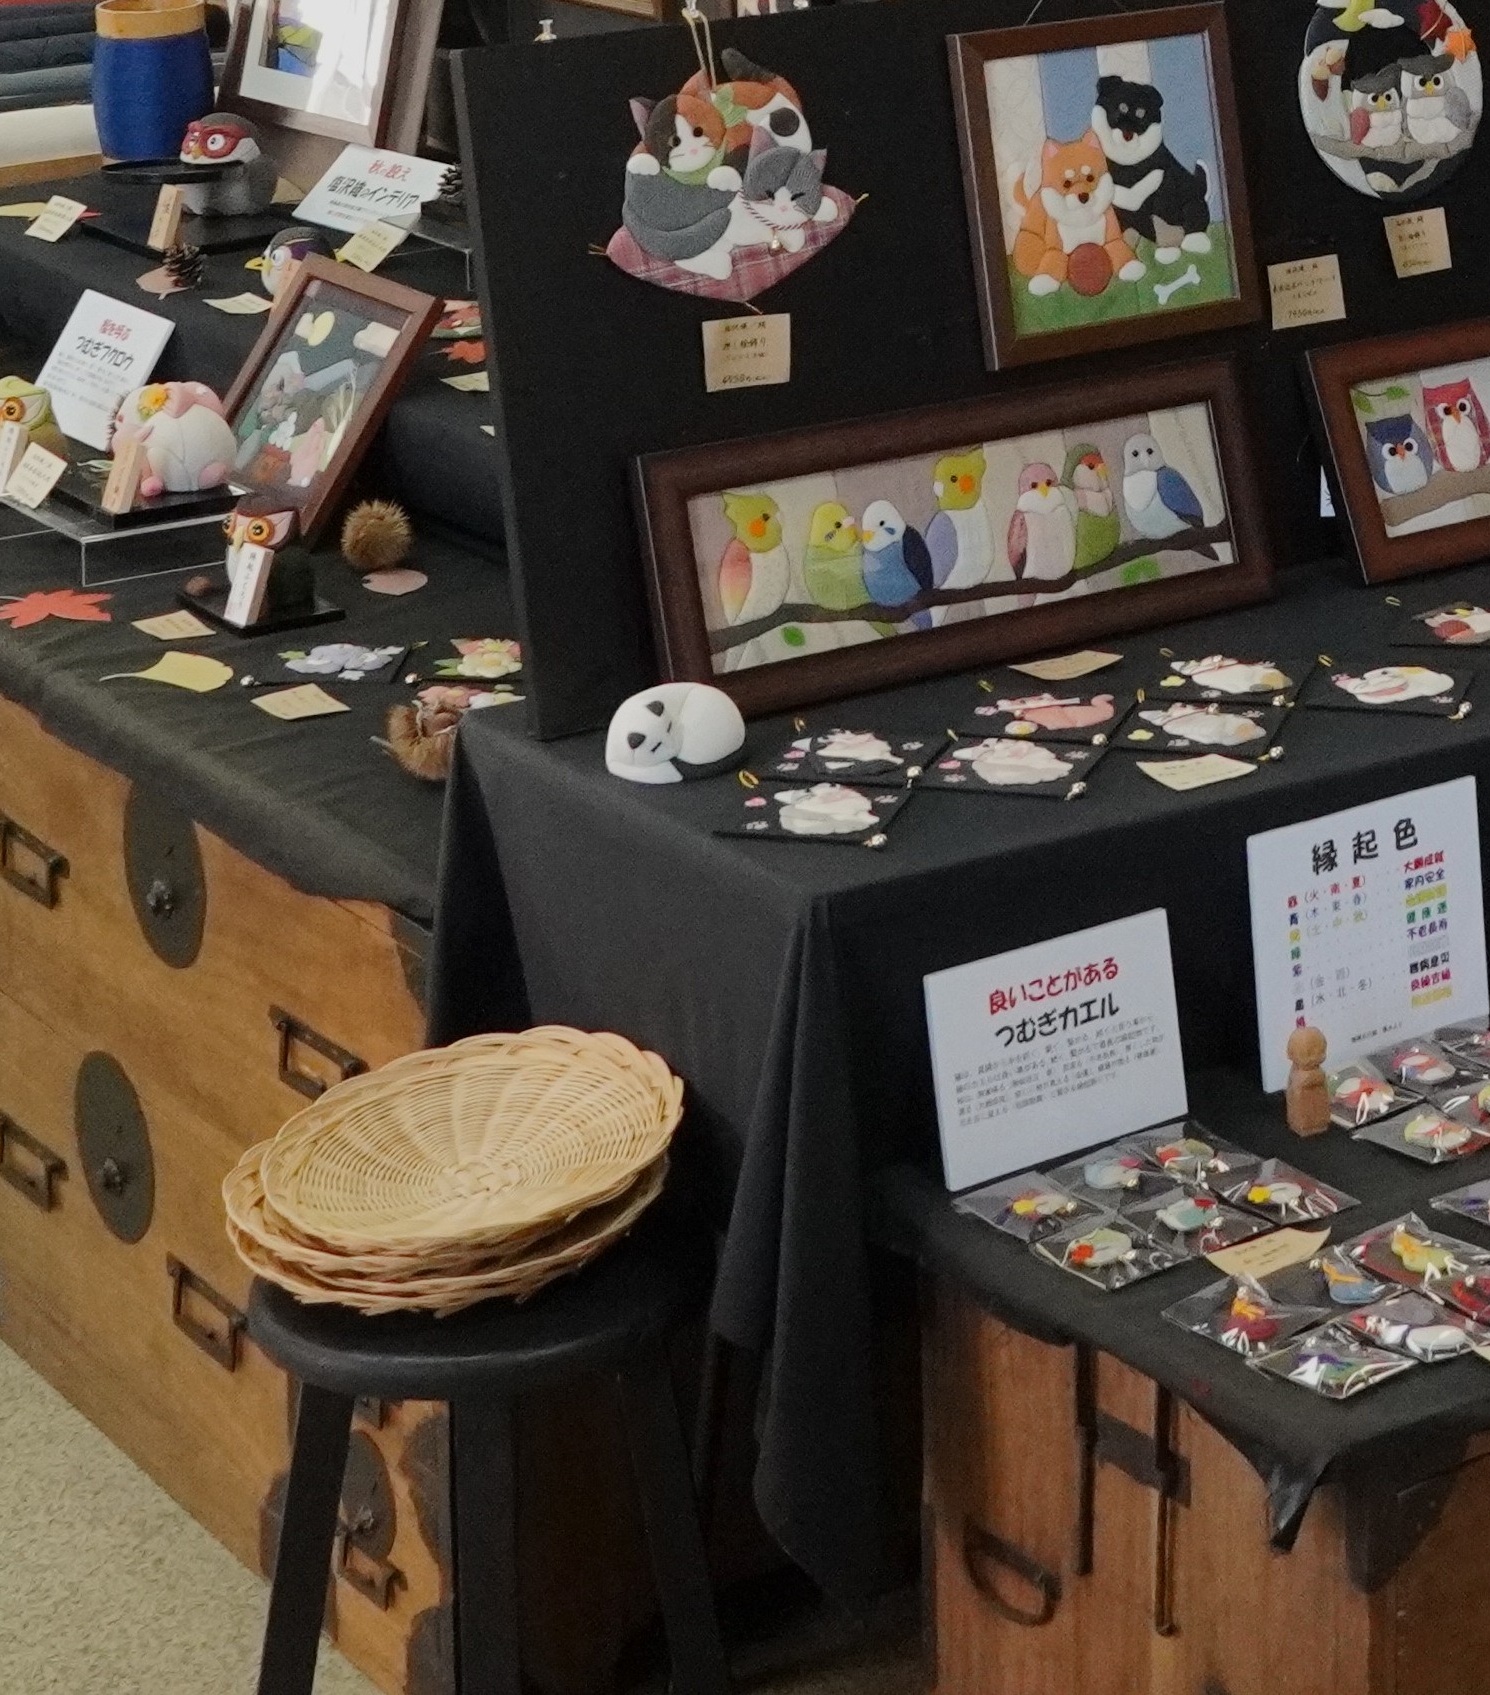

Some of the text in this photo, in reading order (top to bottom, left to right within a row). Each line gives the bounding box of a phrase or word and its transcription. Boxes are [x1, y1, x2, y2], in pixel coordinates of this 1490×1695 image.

[76, 335, 135, 371] つむぎフクロウ
[1312, 817, 1419, 876] 縁起色
[987, 956, 1119, 1016] 良いことがある
[994, 992, 1120, 1048] つむぎカエル
